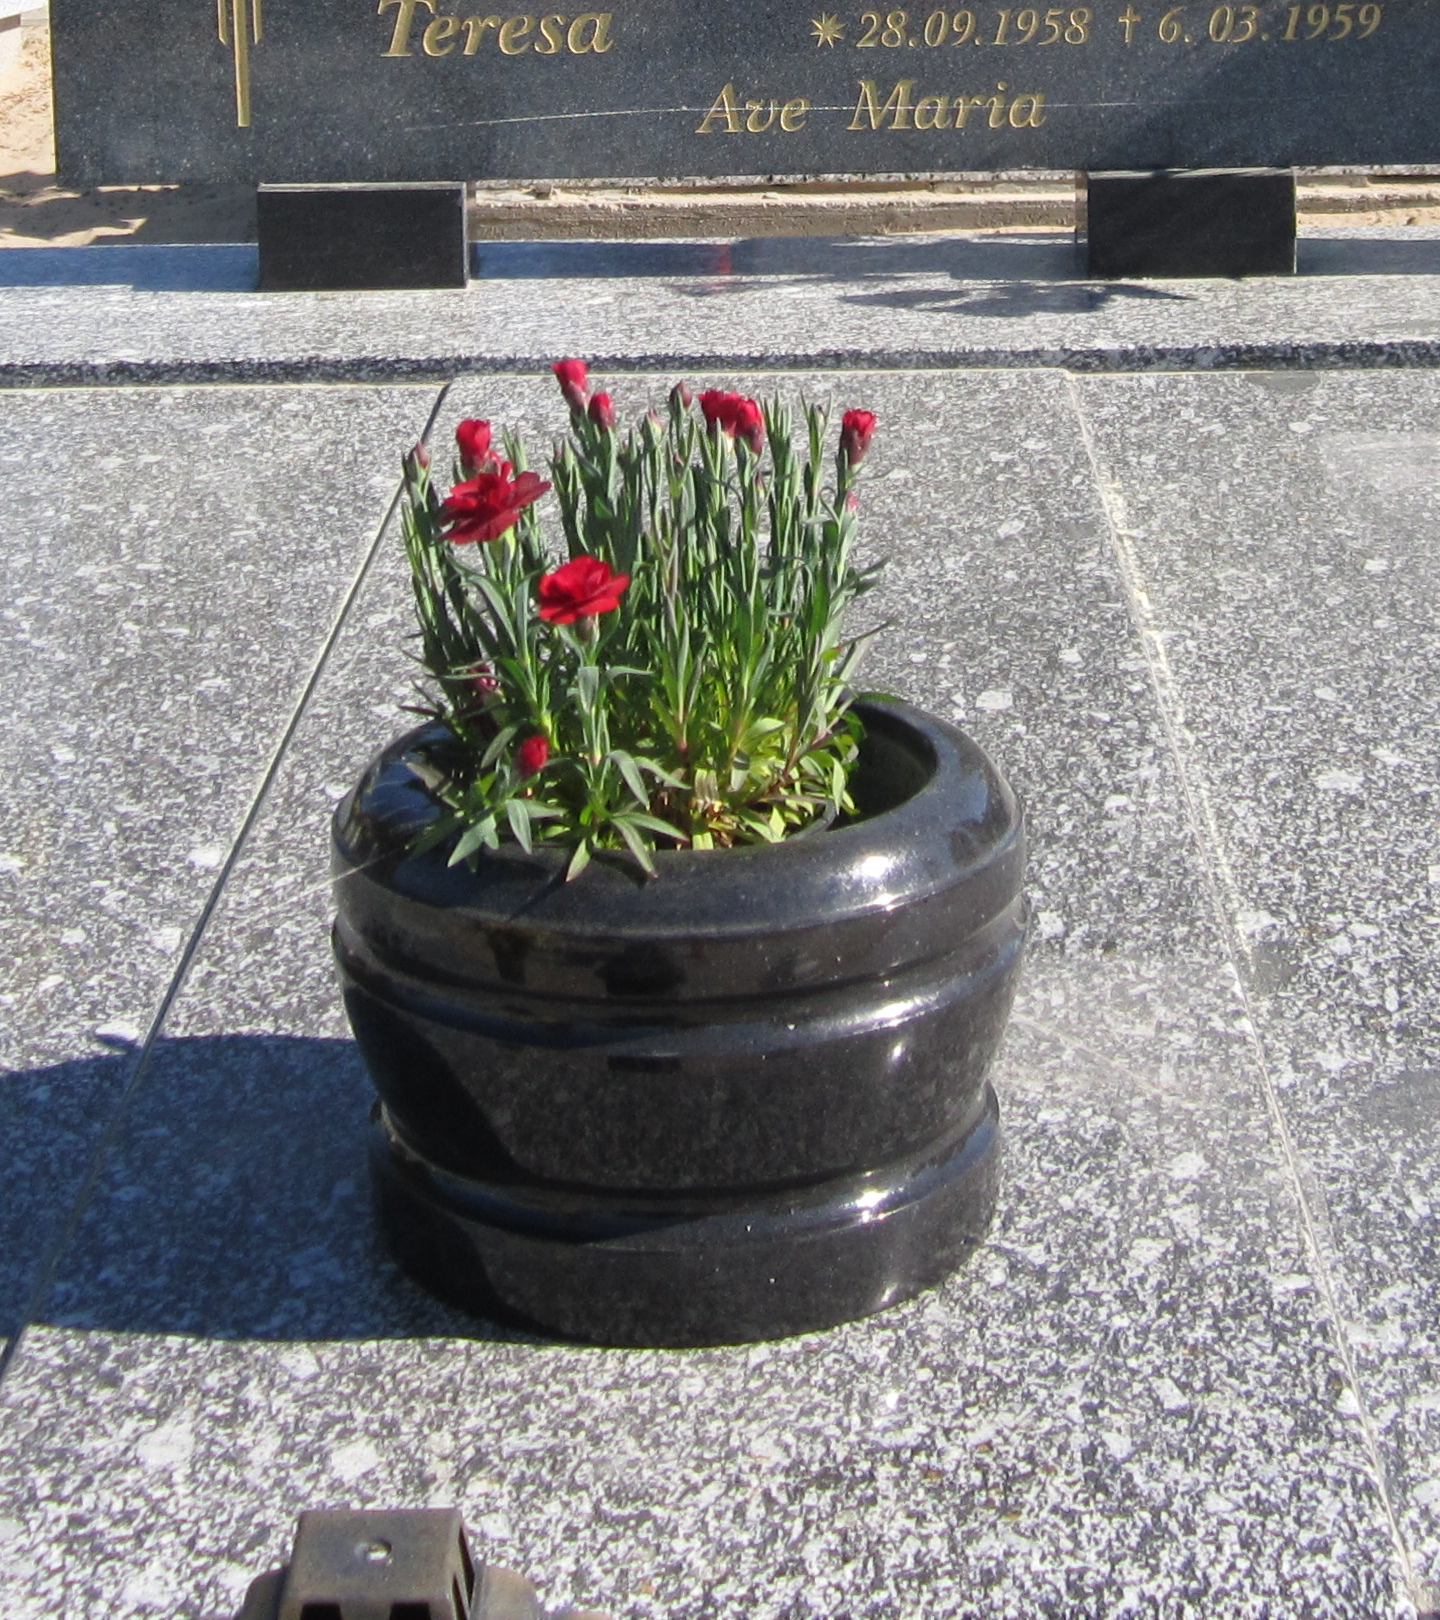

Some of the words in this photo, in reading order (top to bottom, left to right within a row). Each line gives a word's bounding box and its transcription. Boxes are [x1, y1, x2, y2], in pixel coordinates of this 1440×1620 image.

[855, 8, 1092, 48] 28.09.1958
[697, 83, 810, 134] Ave
[847, 80, 1045, 131] Maria
